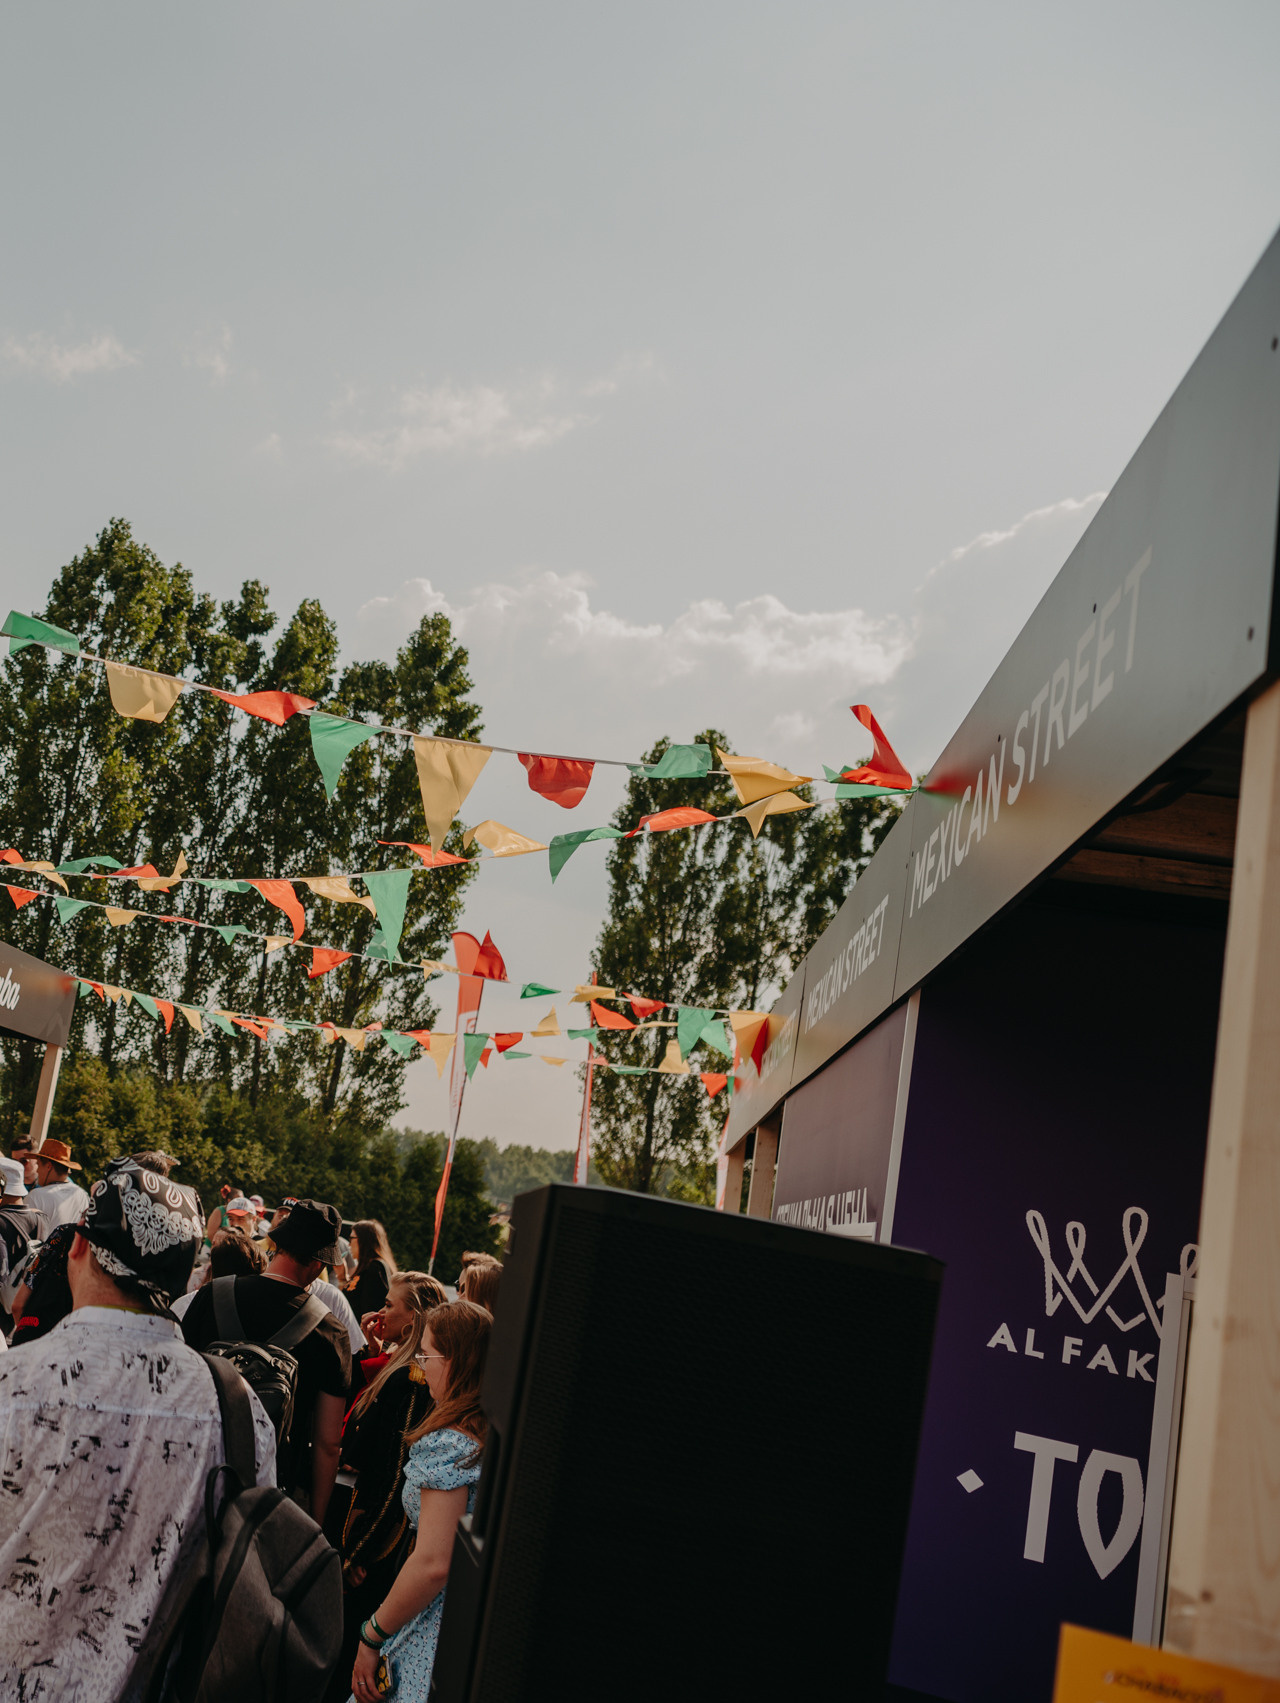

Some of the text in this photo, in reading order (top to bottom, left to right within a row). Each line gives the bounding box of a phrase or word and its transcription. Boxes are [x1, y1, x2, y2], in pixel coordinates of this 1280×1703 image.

[908, 545, 1153, 919] MEXICAN STREET
[804, 894, 889, 1035] MEXICAN STREET
[986, 1322, 1045, 1360] AL
